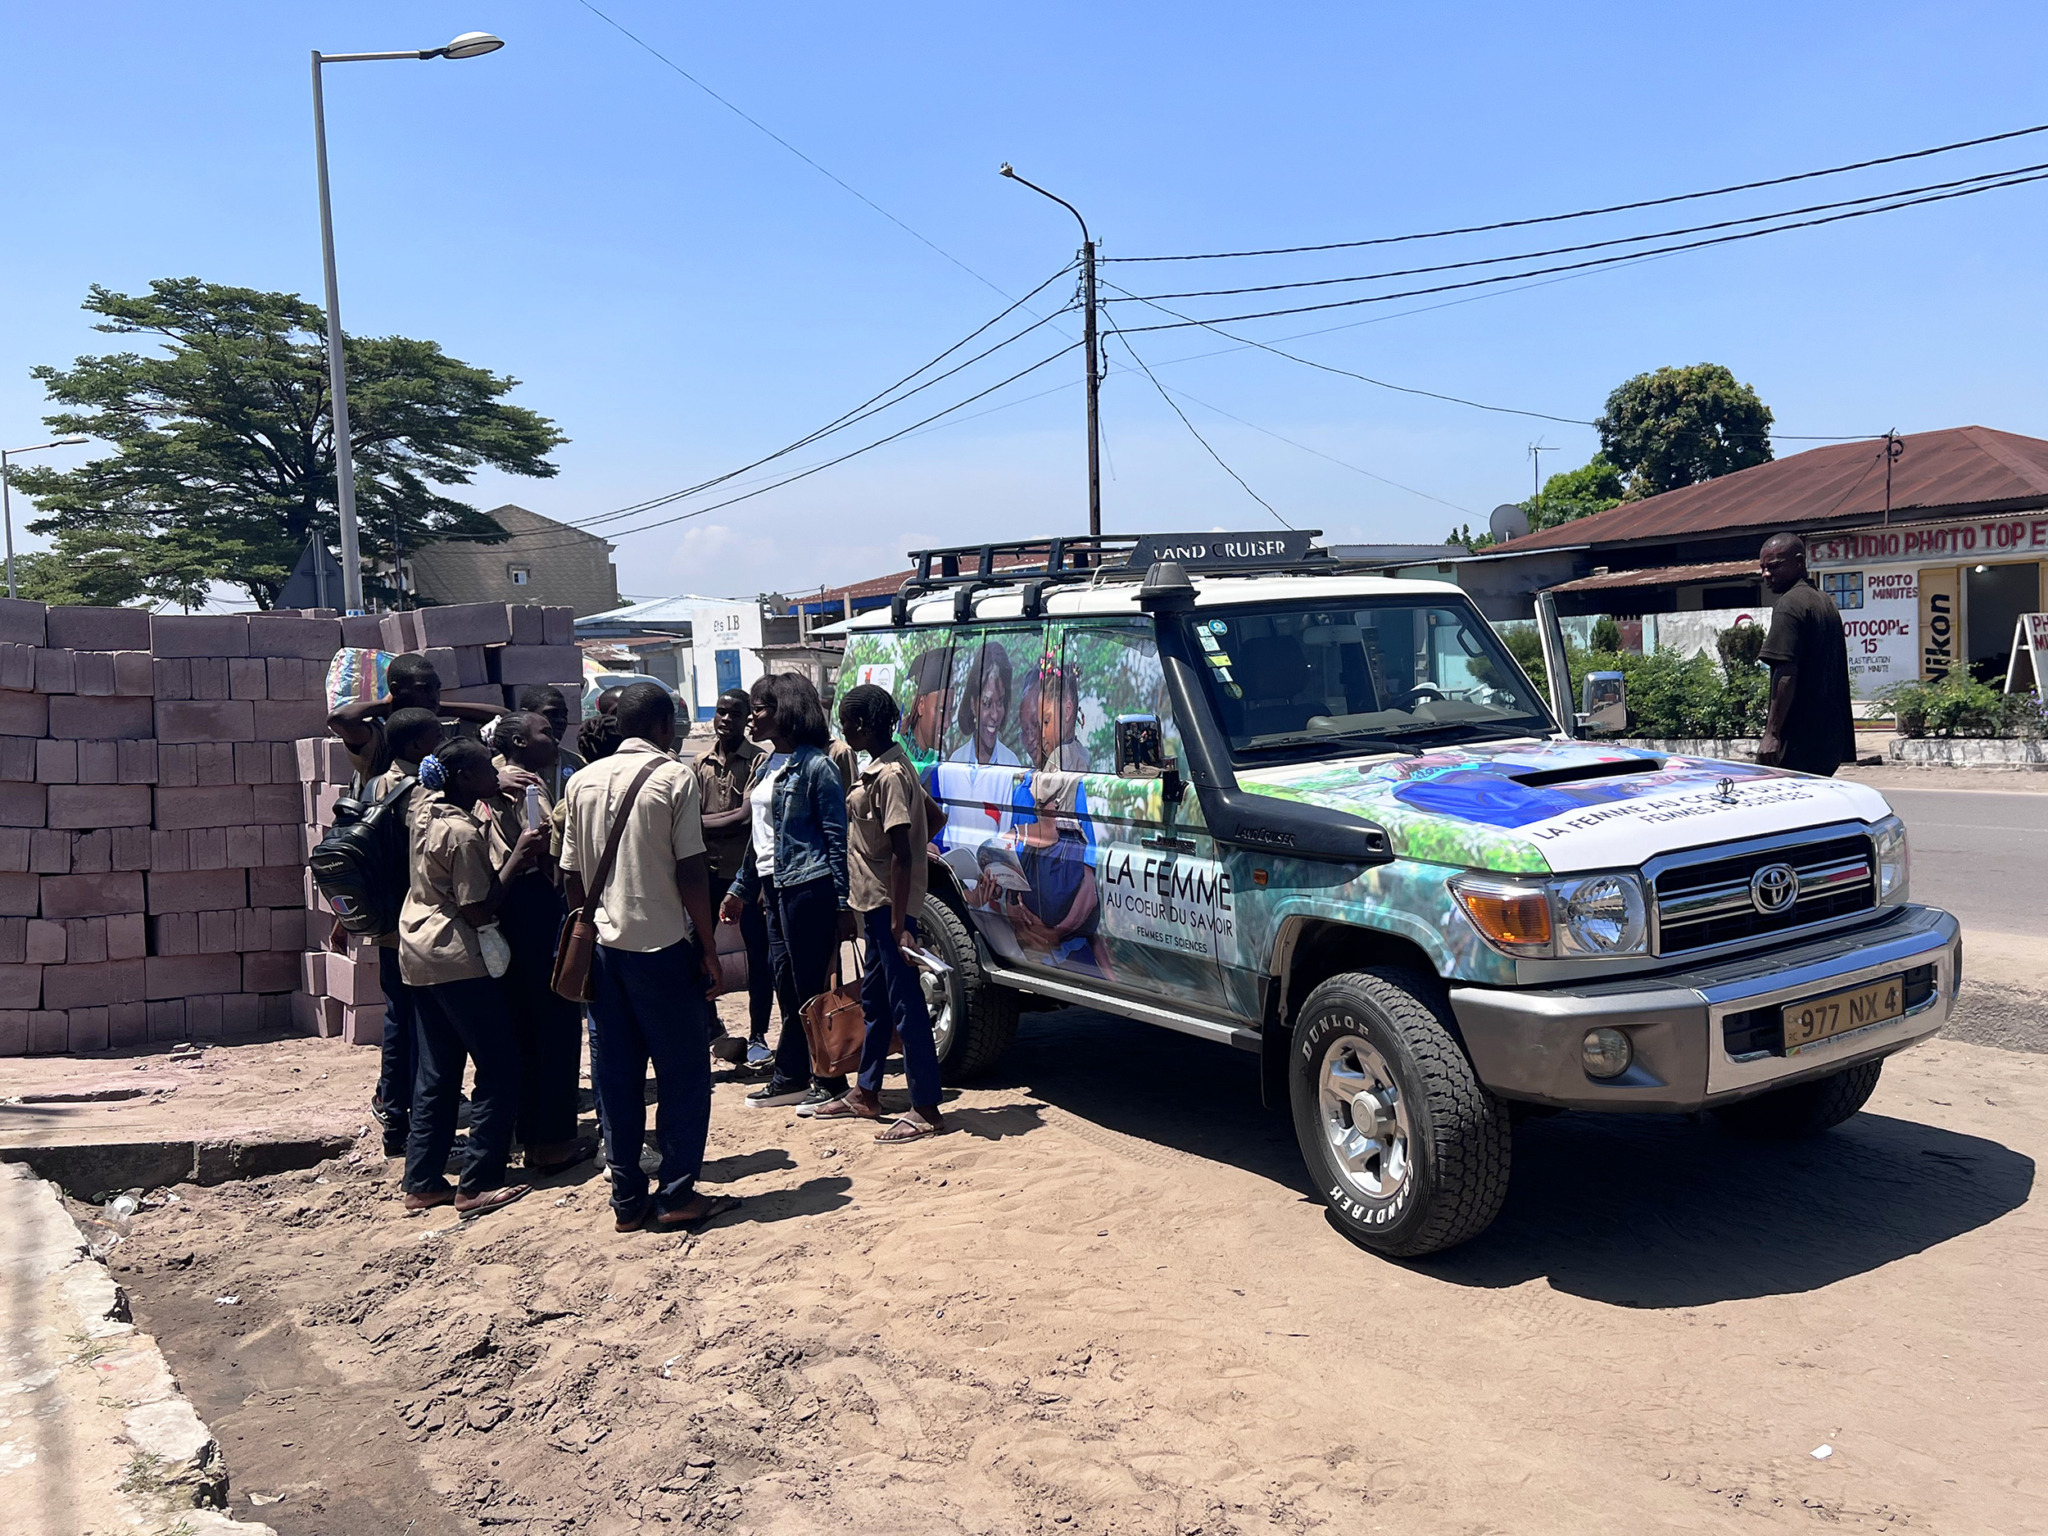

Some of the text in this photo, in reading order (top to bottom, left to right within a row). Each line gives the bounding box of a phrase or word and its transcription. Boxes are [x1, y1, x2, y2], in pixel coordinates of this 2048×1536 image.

[1153, 540, 1286, 560] LAND CRUISER
[1827, 533, 1900, 560] STUDIO
[1903, 526, 1977, 555] PHOTO
[1981, 522, 2026, 549] TOP
[2031, 520, 2048, 547] E
[1868, 574, 1914, 588] PHOTO
[1872, 586, 1919, 600] MINUTES
[1860, 638, 1878, 654] 15
[1925, 593, 1951, 684] Nikon
[1532, 827, 1571, 840] LA
[1566, 805, 1648, 830] FEMME
[1648, 799, 1681, 810] AU
[1638, 804, 1716, 824] FEMMES
[1105, 850, 1232, 912] LA FEMME
[1106, 892, 1233, 938] AU COEUR DU SAVOIR
[1137, 926, 1207, 953] FEMMES ET SCIENCES
[1800, 1004, 1840, 1038] 977
[1849, 991, 1878, 1025] NX
[1884, 986, 1896, 1013] 4
[1302, 1014, 1369, 1061] DUNLOP
[1329, 1159, 1414, 1224] GRANDTREK
